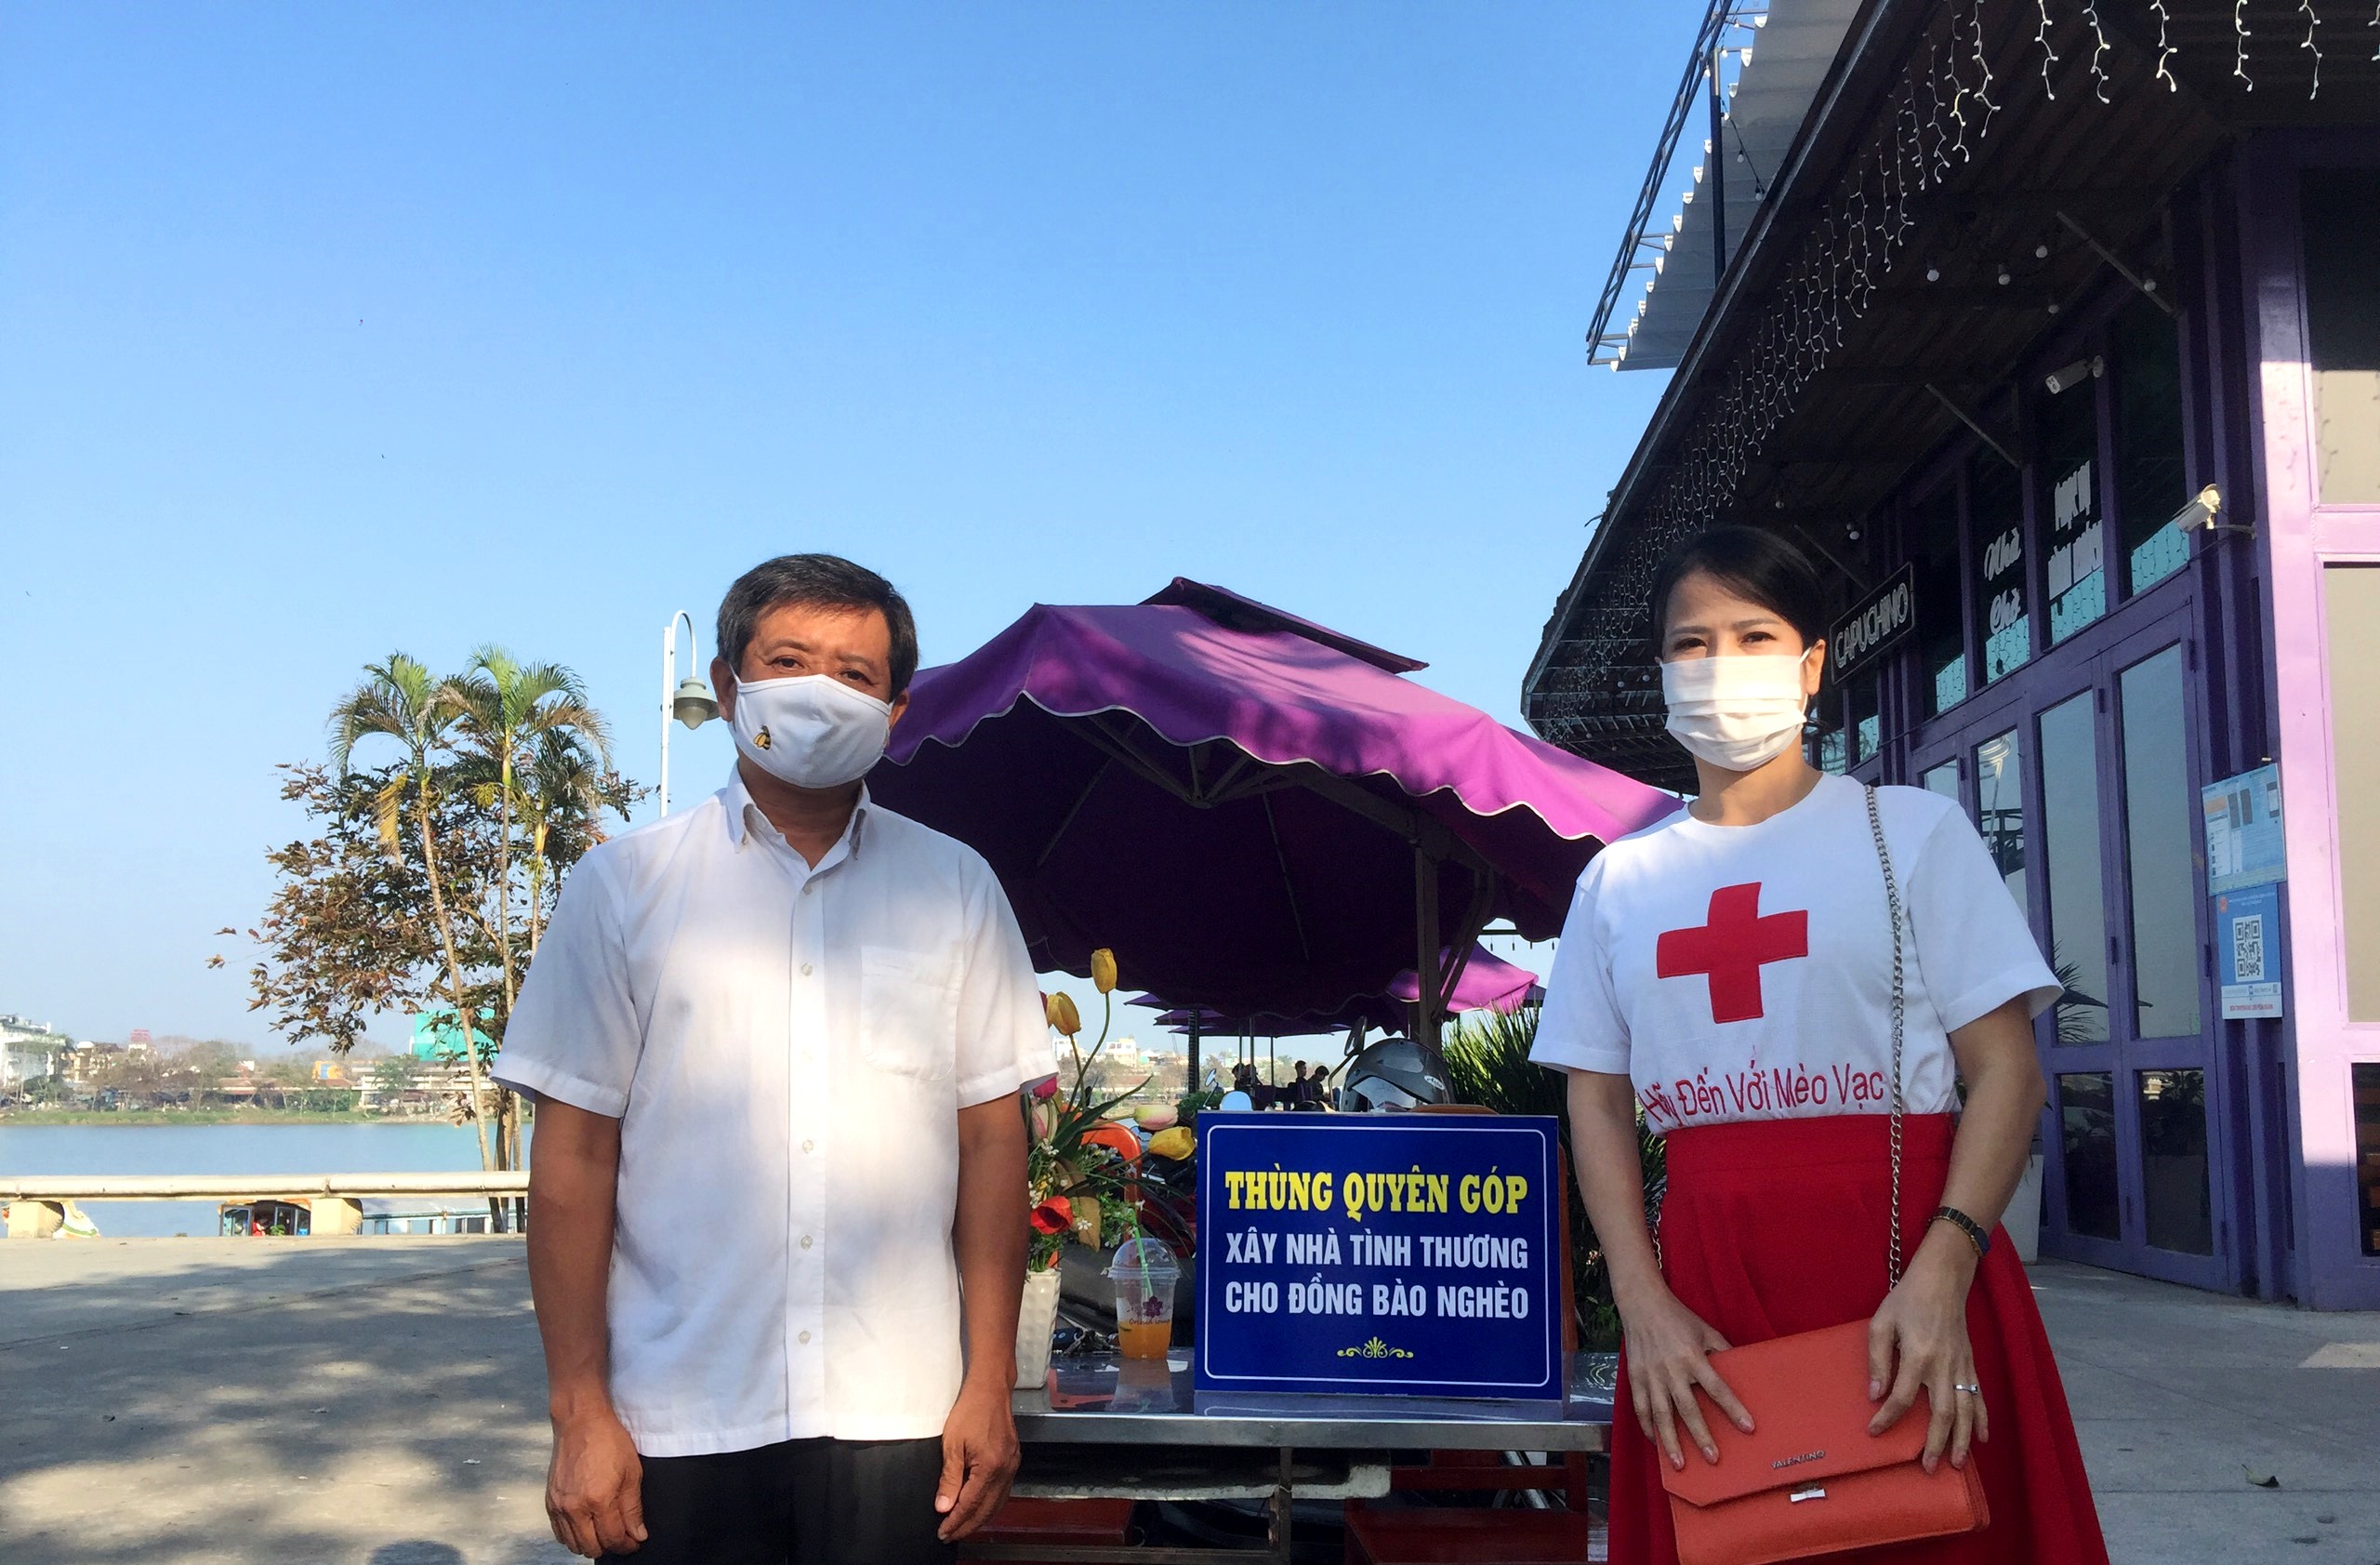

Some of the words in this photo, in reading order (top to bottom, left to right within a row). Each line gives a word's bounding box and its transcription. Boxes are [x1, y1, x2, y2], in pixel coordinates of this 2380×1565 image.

[1835, 582, 1909, 669] CAPUCHINO
[1675, 1066, 1726, 1116] Đến
[1726, 1060, 1771, 1113] Với
[1774, 1062, 1828, 1108] Mèo
[1832, 1063, 1884, 1109] Vạc
[1225, 1163, 1332, 1211] THÙNG
[1343, 1165, 1448, 1222] QUYÊN
[1460, 1166, 1527, 1214] GÓP
[1226, 1227, 1276, 1263] XÂY
[1287, 1228, 1341, 1264] NHÀ
[1350, 1228, 1410, 1266] TÌNH
[1421, 1234, 1527, 1268] THƯƠNG
[1226, 1282, 1277, 1313] CHO
[1289, 1273, 1361, 1314] ĐỒNG
[1373, 1279, 1425, 1316] BÀO
[1438, 1281, 1527, 1319] NGHÈO
